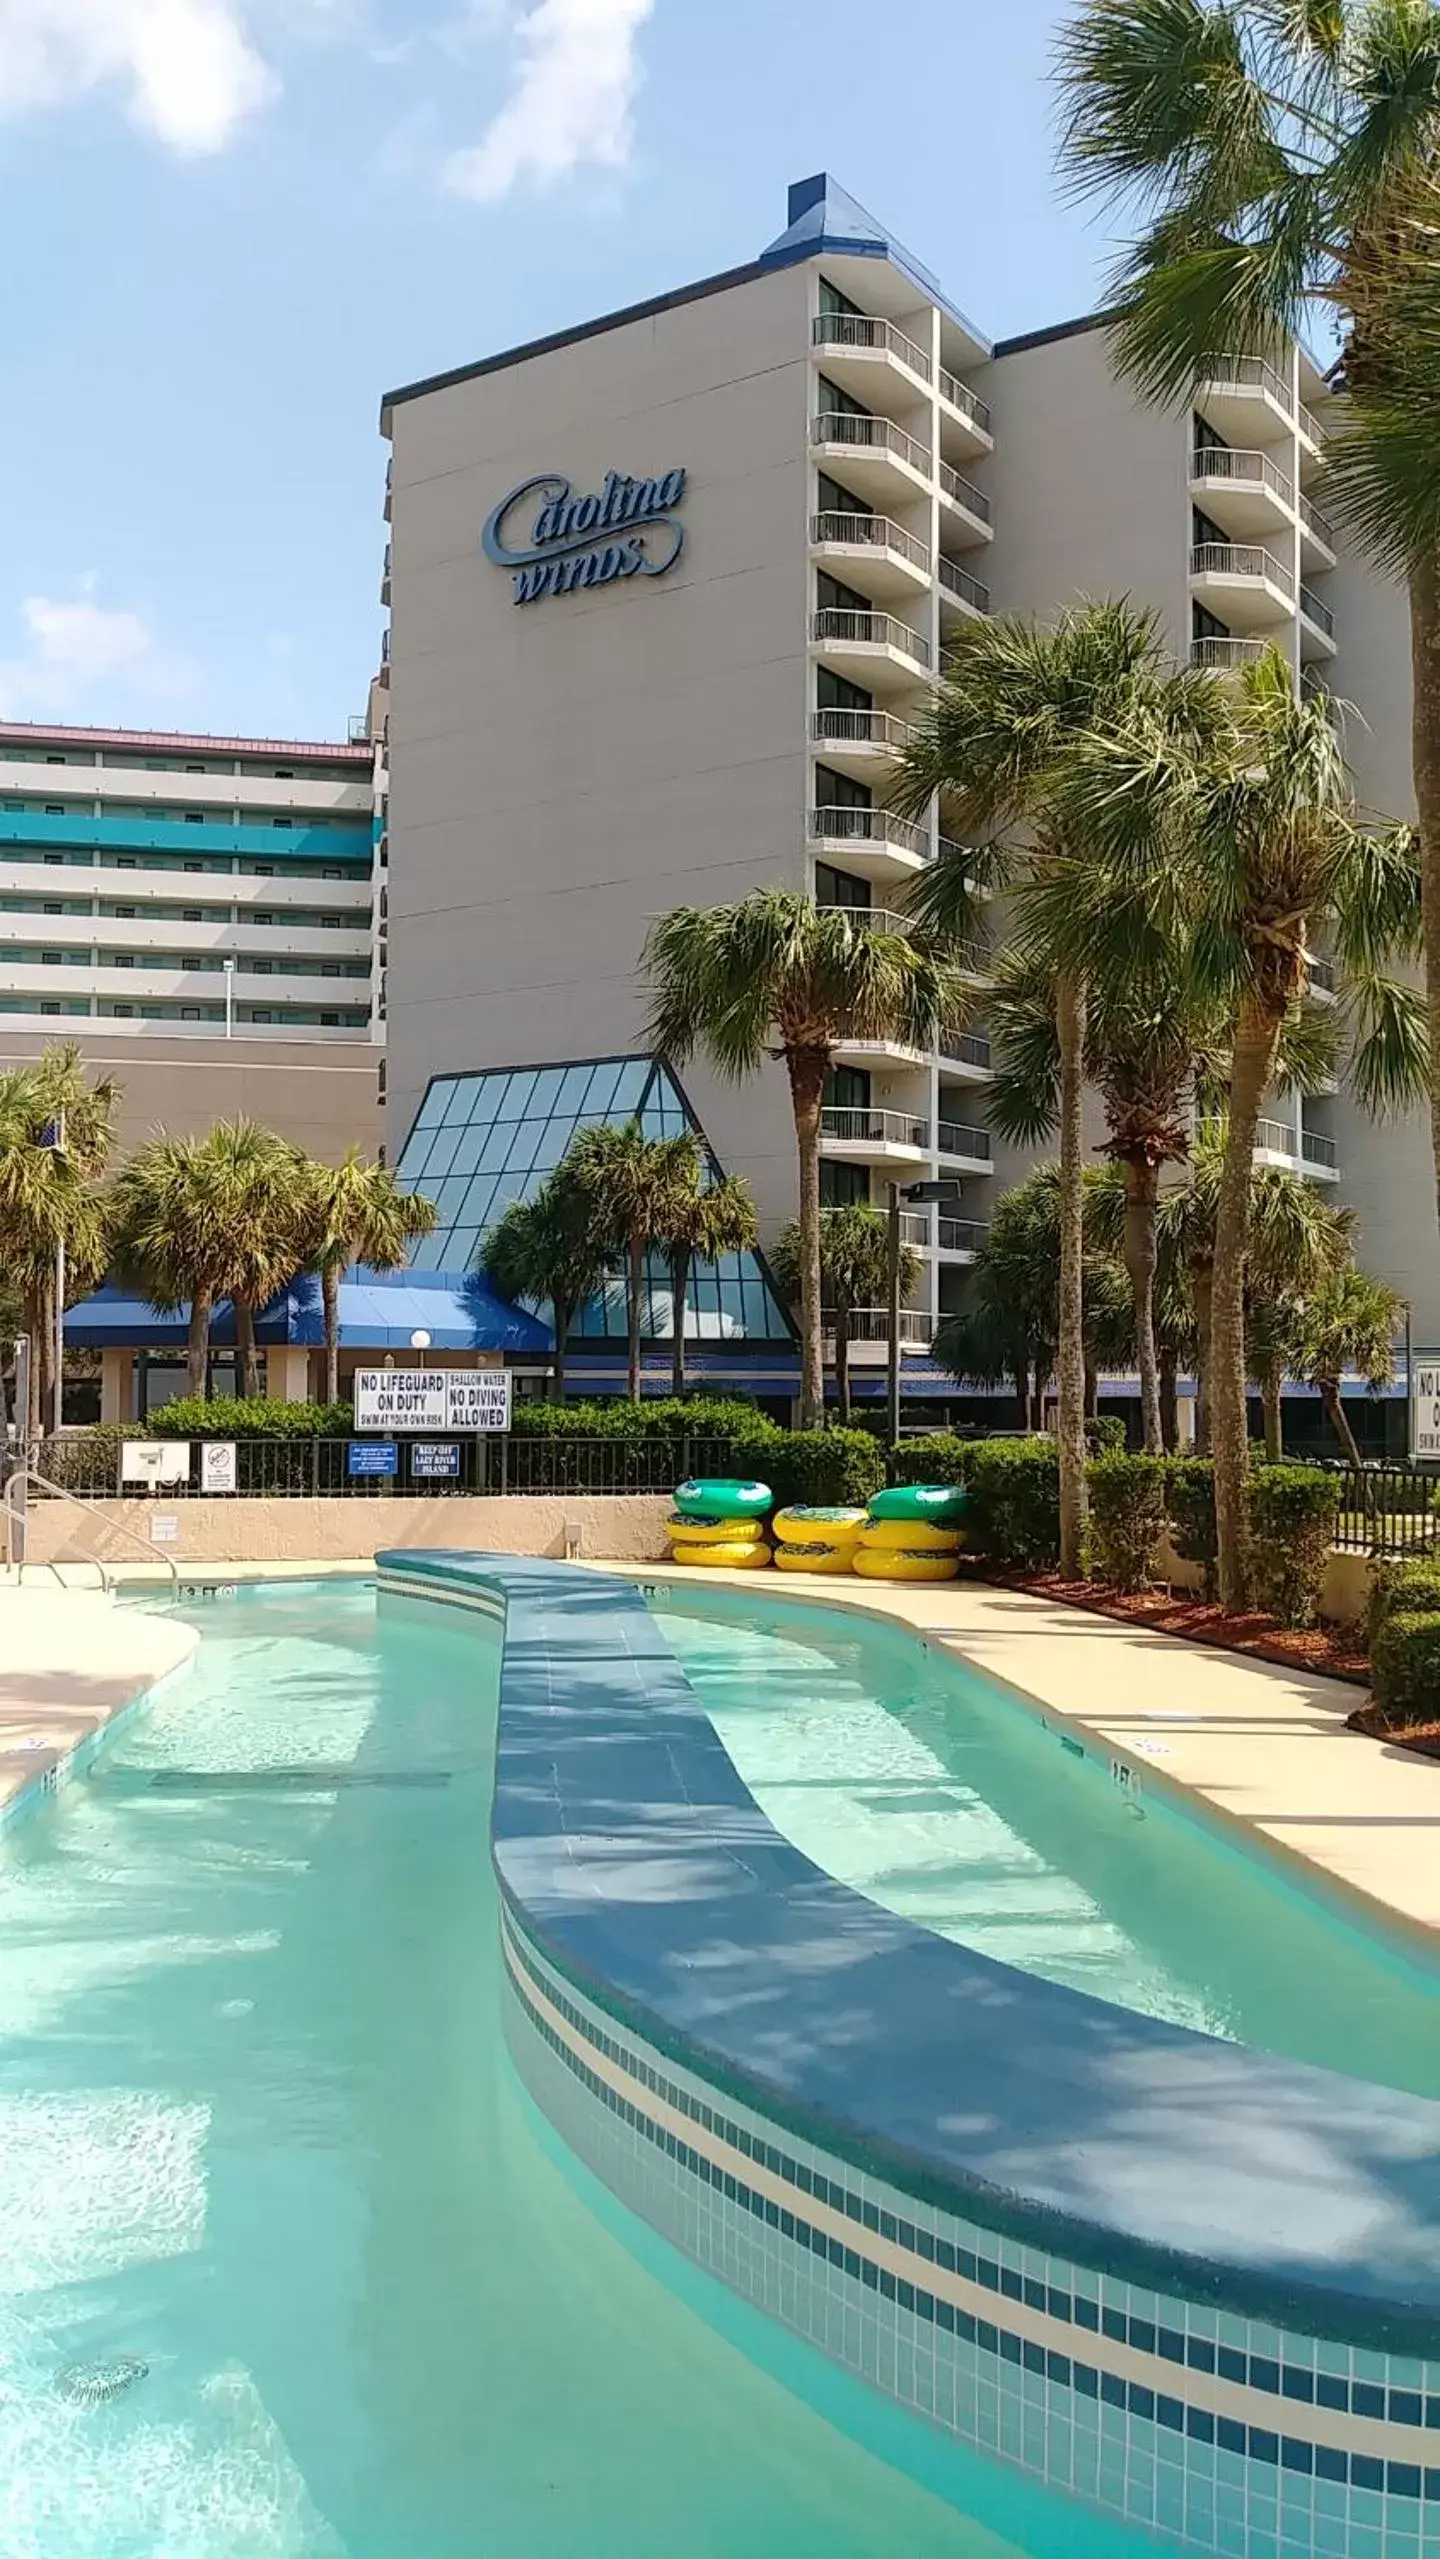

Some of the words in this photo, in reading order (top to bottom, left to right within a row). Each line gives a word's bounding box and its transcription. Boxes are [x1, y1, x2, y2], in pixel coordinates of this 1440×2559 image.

[481, 467, 685, 566] Carolina
[361, 1374, 377, 1392] NO
[381, 1374, 443, 1392] LIFEGUARD
[450, 1374, 481, 1386] SHALLOW
[483, 1374, 506, 1386] WATER
[1419, 1372, 1433, 1396] NO
[377, 1394, 393, 1411] ON
[397, 1394, 426, 1411] DUTY
[450, 1389, 465, 1406] NO
[469, 1389, 506, 1406] DIVING
[361, 1414, 379, 1425] SWIM
[380, 1414, 389, 1425] AT
[390, 1414, 409, 1425] YOUR
[411, 1414, 425, 1425] OWN
[426, 1414, 443, 1425] RISK
[451, 1408, 504, 1425] ALLOWED
[418, 1446, 437, 1455] KEEP
[438, 1446, 453, 1455] OFF
[416, 1455, 433, 1465] LAZY
[434, 1455, 456, 1465] RIVER
[422, 1465, 450, 1473] ISLAND
